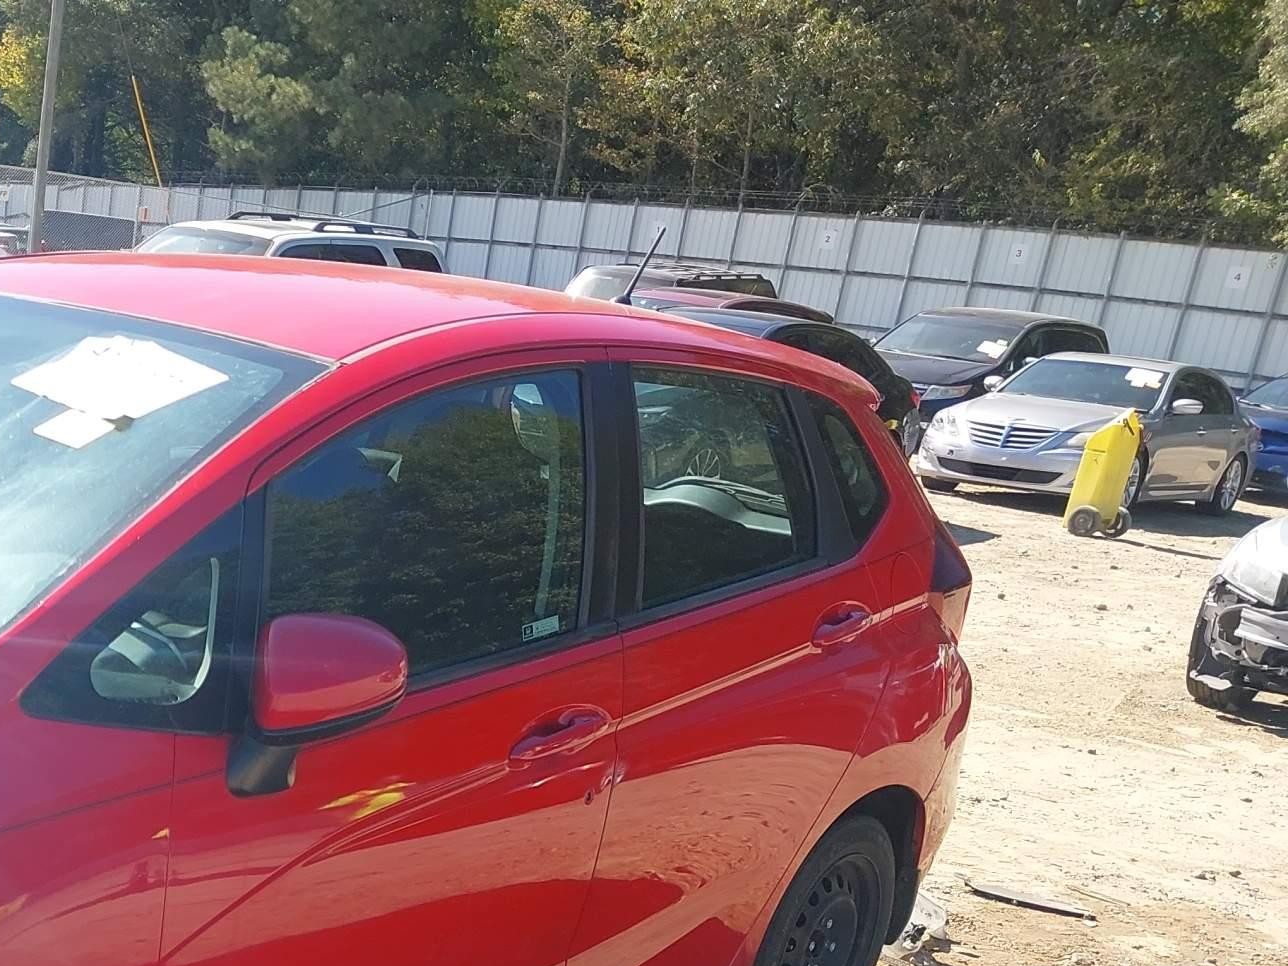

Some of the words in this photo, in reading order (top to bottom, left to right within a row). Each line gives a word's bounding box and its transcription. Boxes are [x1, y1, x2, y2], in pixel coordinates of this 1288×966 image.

[824, 235, 831, 243] 2
[1015, 249, 1023, 258] 3
[1233, 272, 1241, 281] 4
